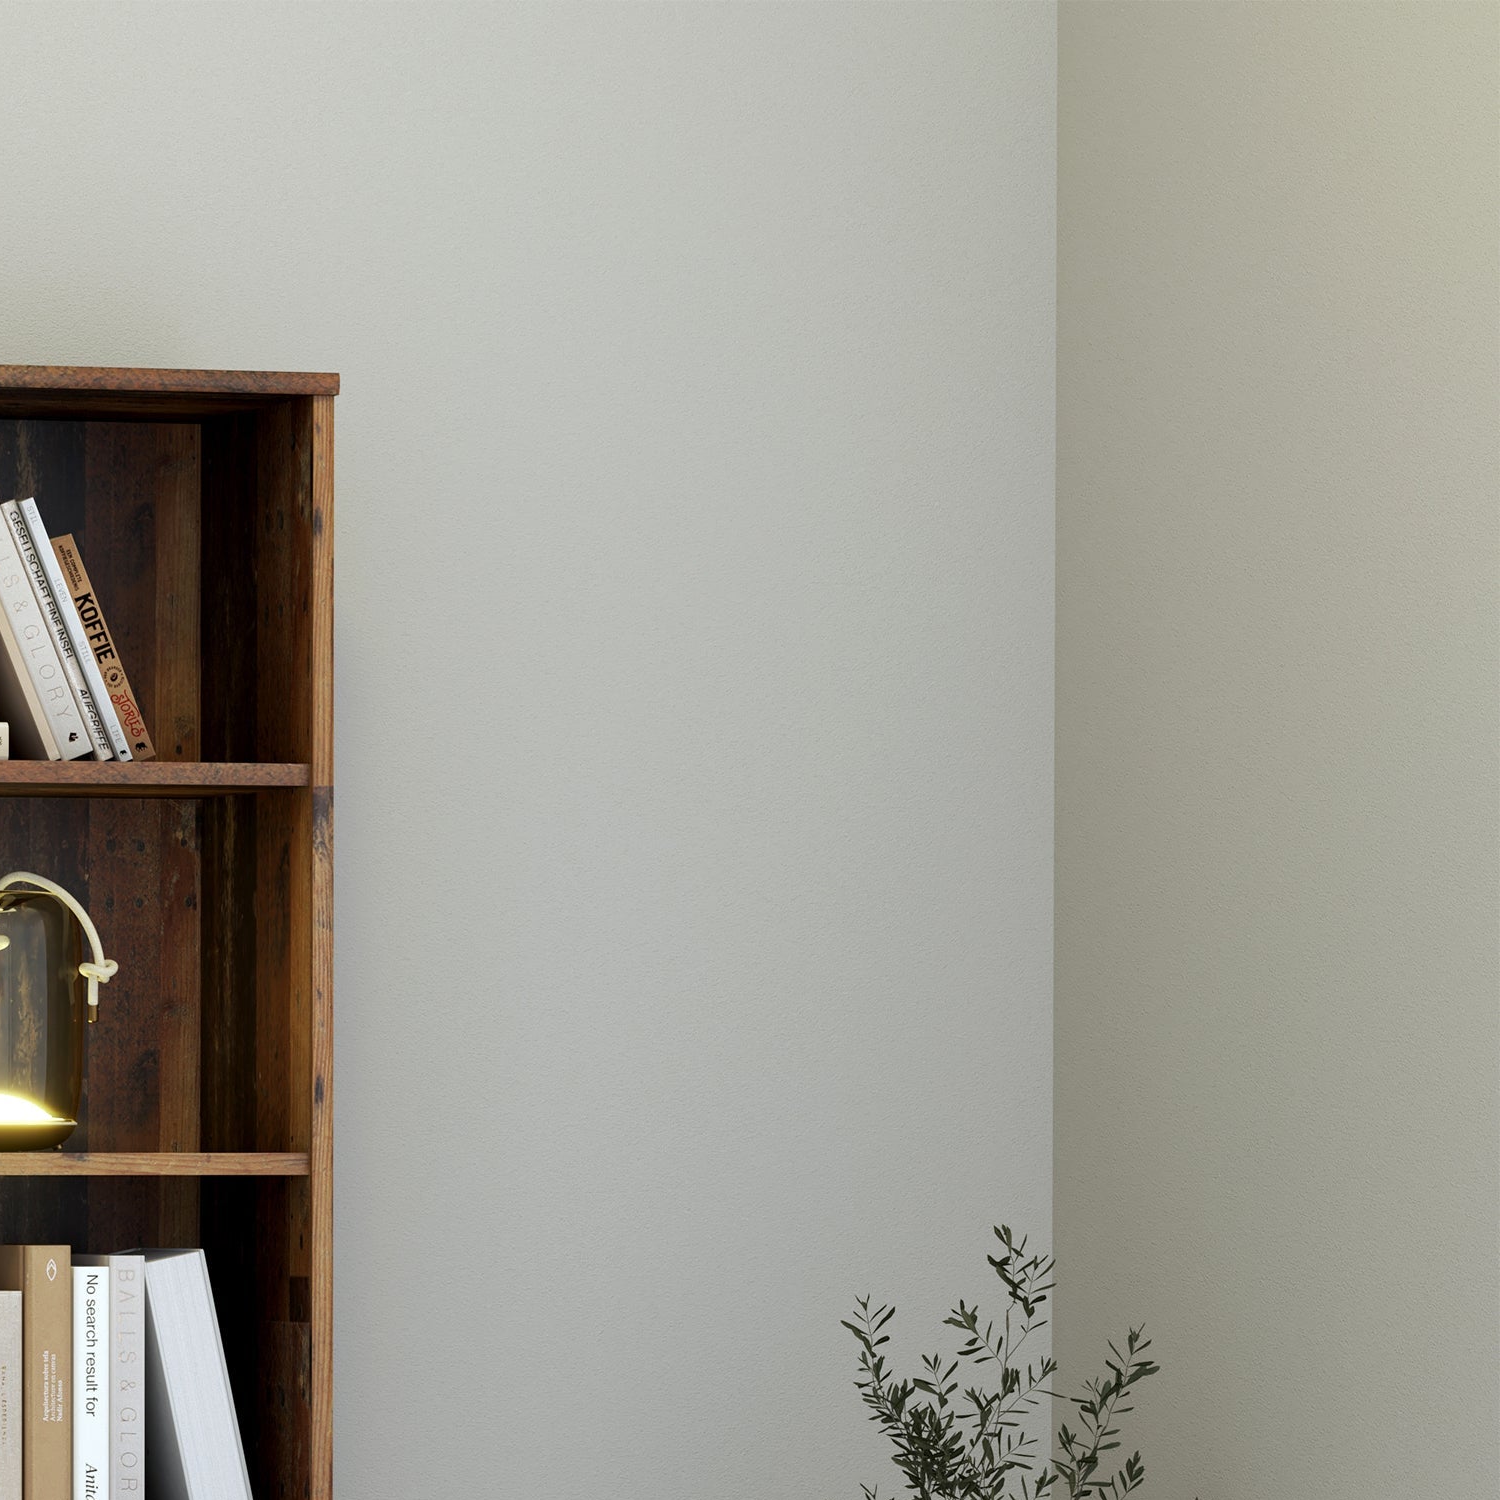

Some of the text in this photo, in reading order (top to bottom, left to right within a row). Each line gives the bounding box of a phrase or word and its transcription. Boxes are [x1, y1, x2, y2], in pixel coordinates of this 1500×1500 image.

[74, 592, 115, 664] KOFFIE
[24, 625, 73, 717] GLORY
[110, 689, 145, 737] STORIES
[86, 1274, 98, 1417] No search result for
[120, 1379, 137, 1392] &
